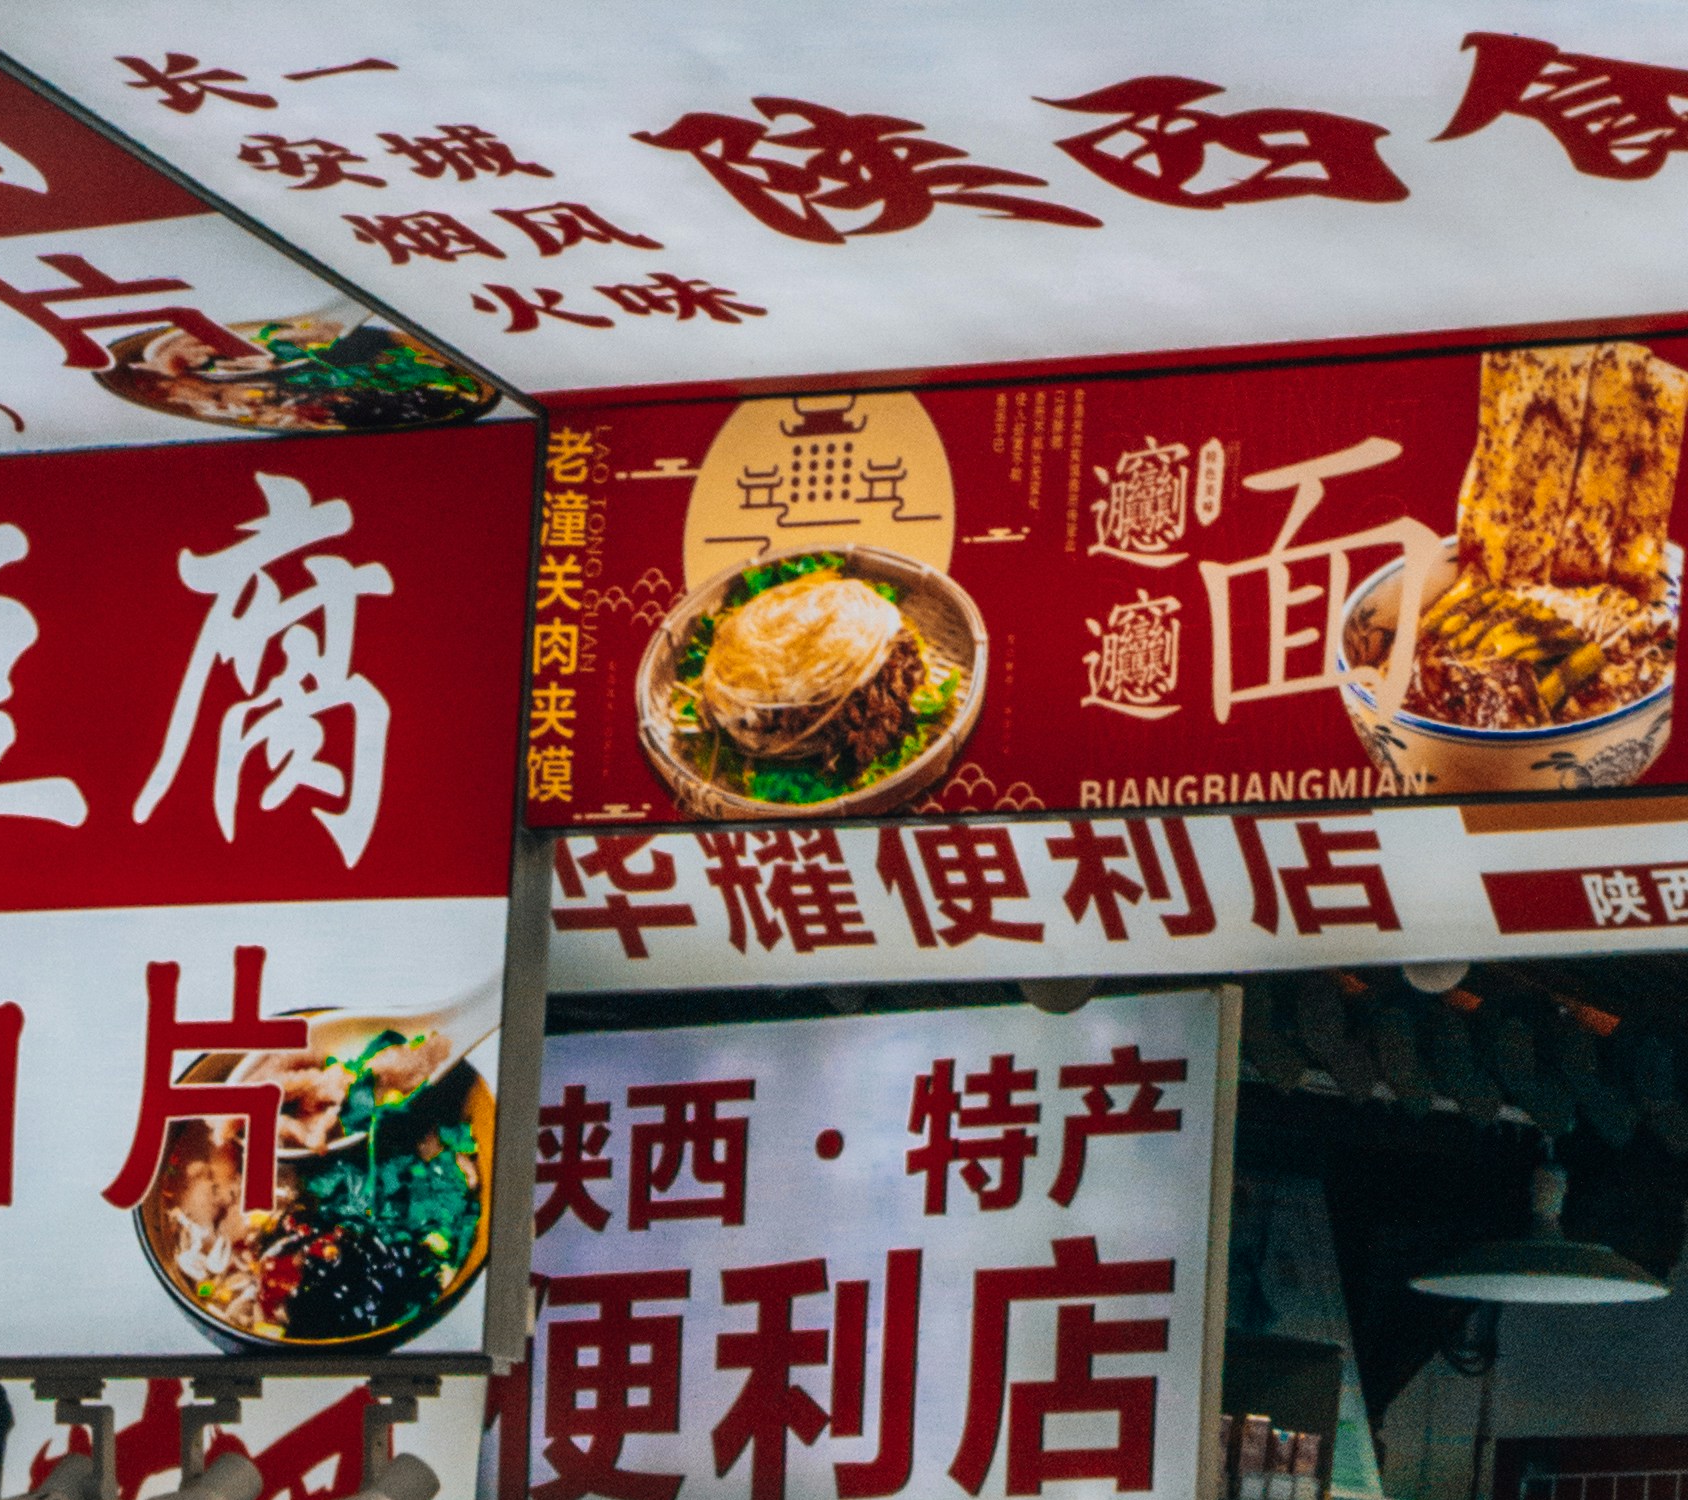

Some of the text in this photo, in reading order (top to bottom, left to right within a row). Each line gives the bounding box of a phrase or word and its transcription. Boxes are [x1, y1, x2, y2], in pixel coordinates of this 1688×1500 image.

[526, 427, 594, 802] 老潼关肉夹馍
[1079, 766, 1429, 809] BIANGBIANGMIAN
[551, 806, 1404, 960] 华耀便利店
